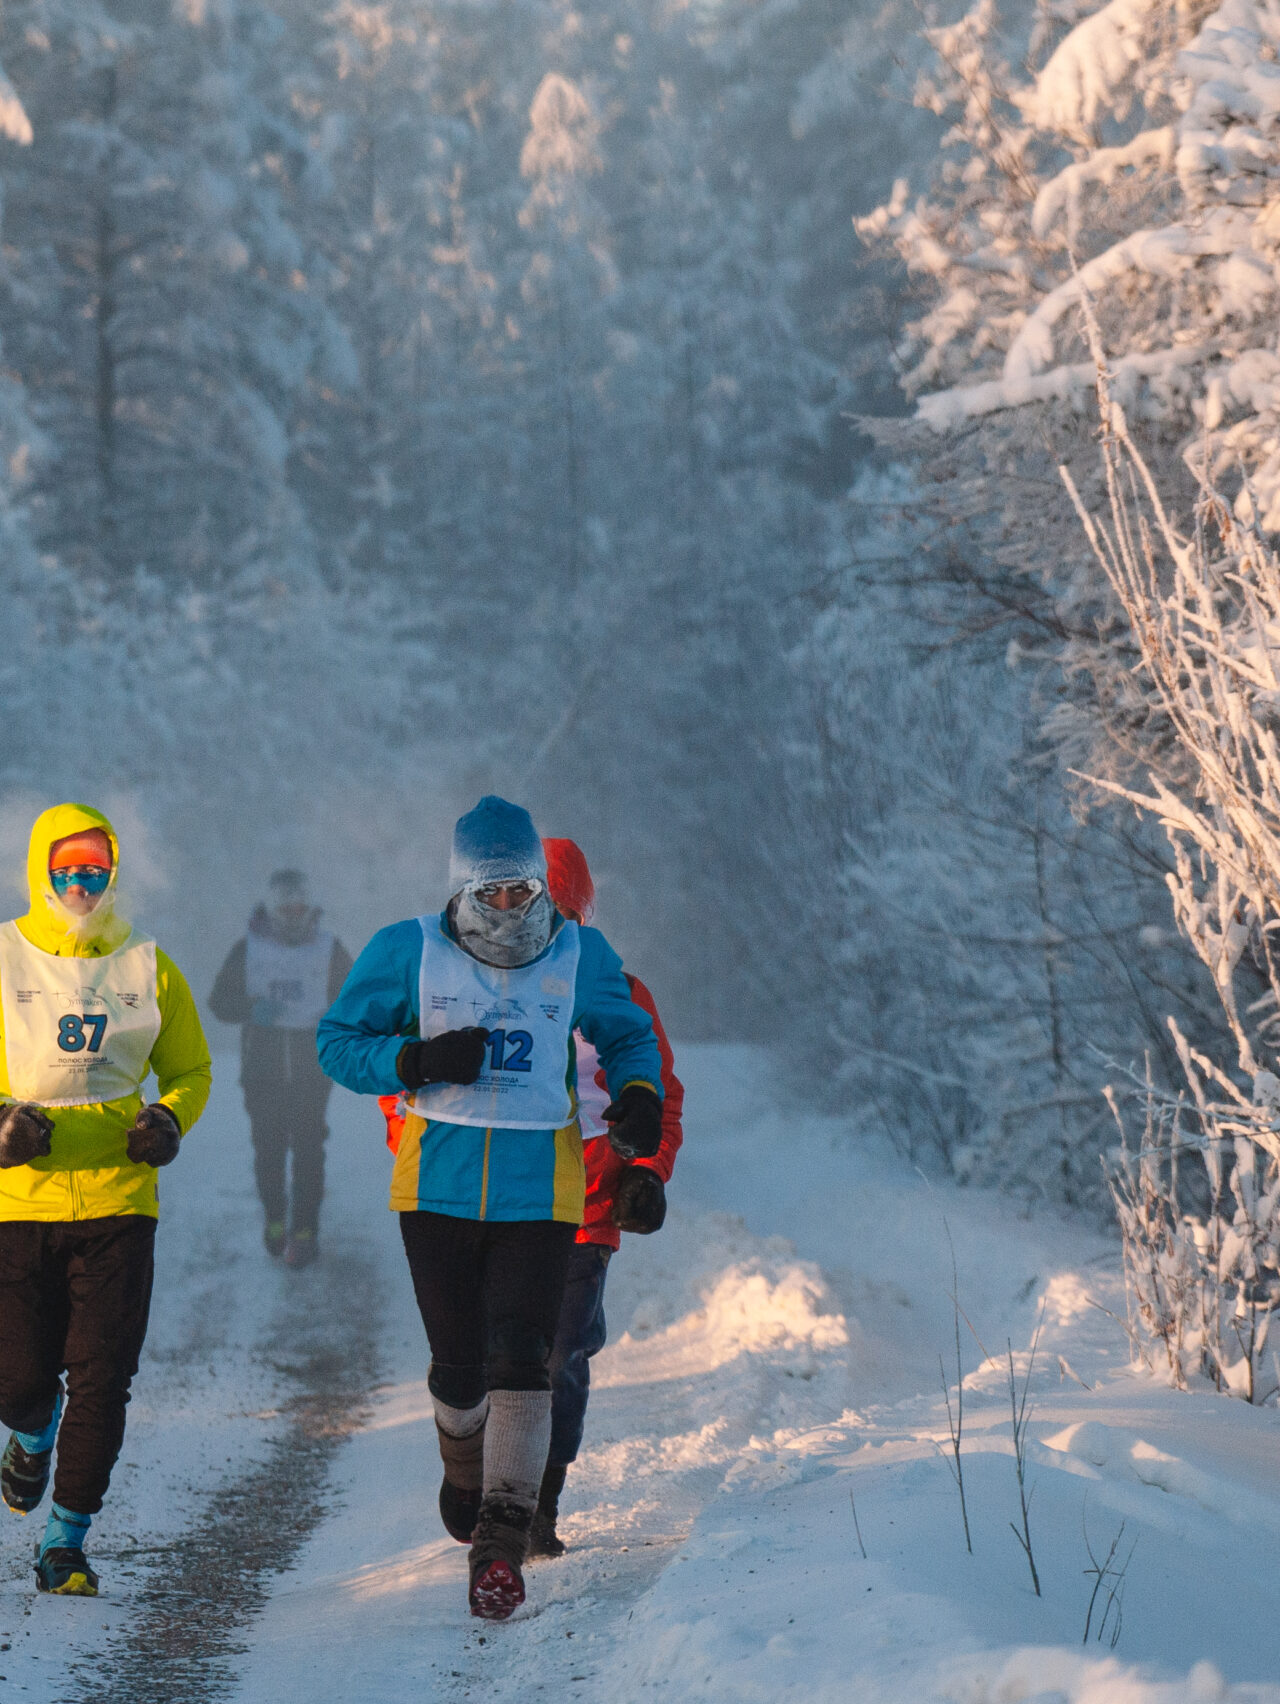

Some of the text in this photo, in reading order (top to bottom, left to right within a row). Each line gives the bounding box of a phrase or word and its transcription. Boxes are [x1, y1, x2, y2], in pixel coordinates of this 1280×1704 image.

[57, 1014, 108, 1052] 87
[462, 1027, 534, 1072] 12
[491, 1075, 519, 1083] ХОЛОДА
